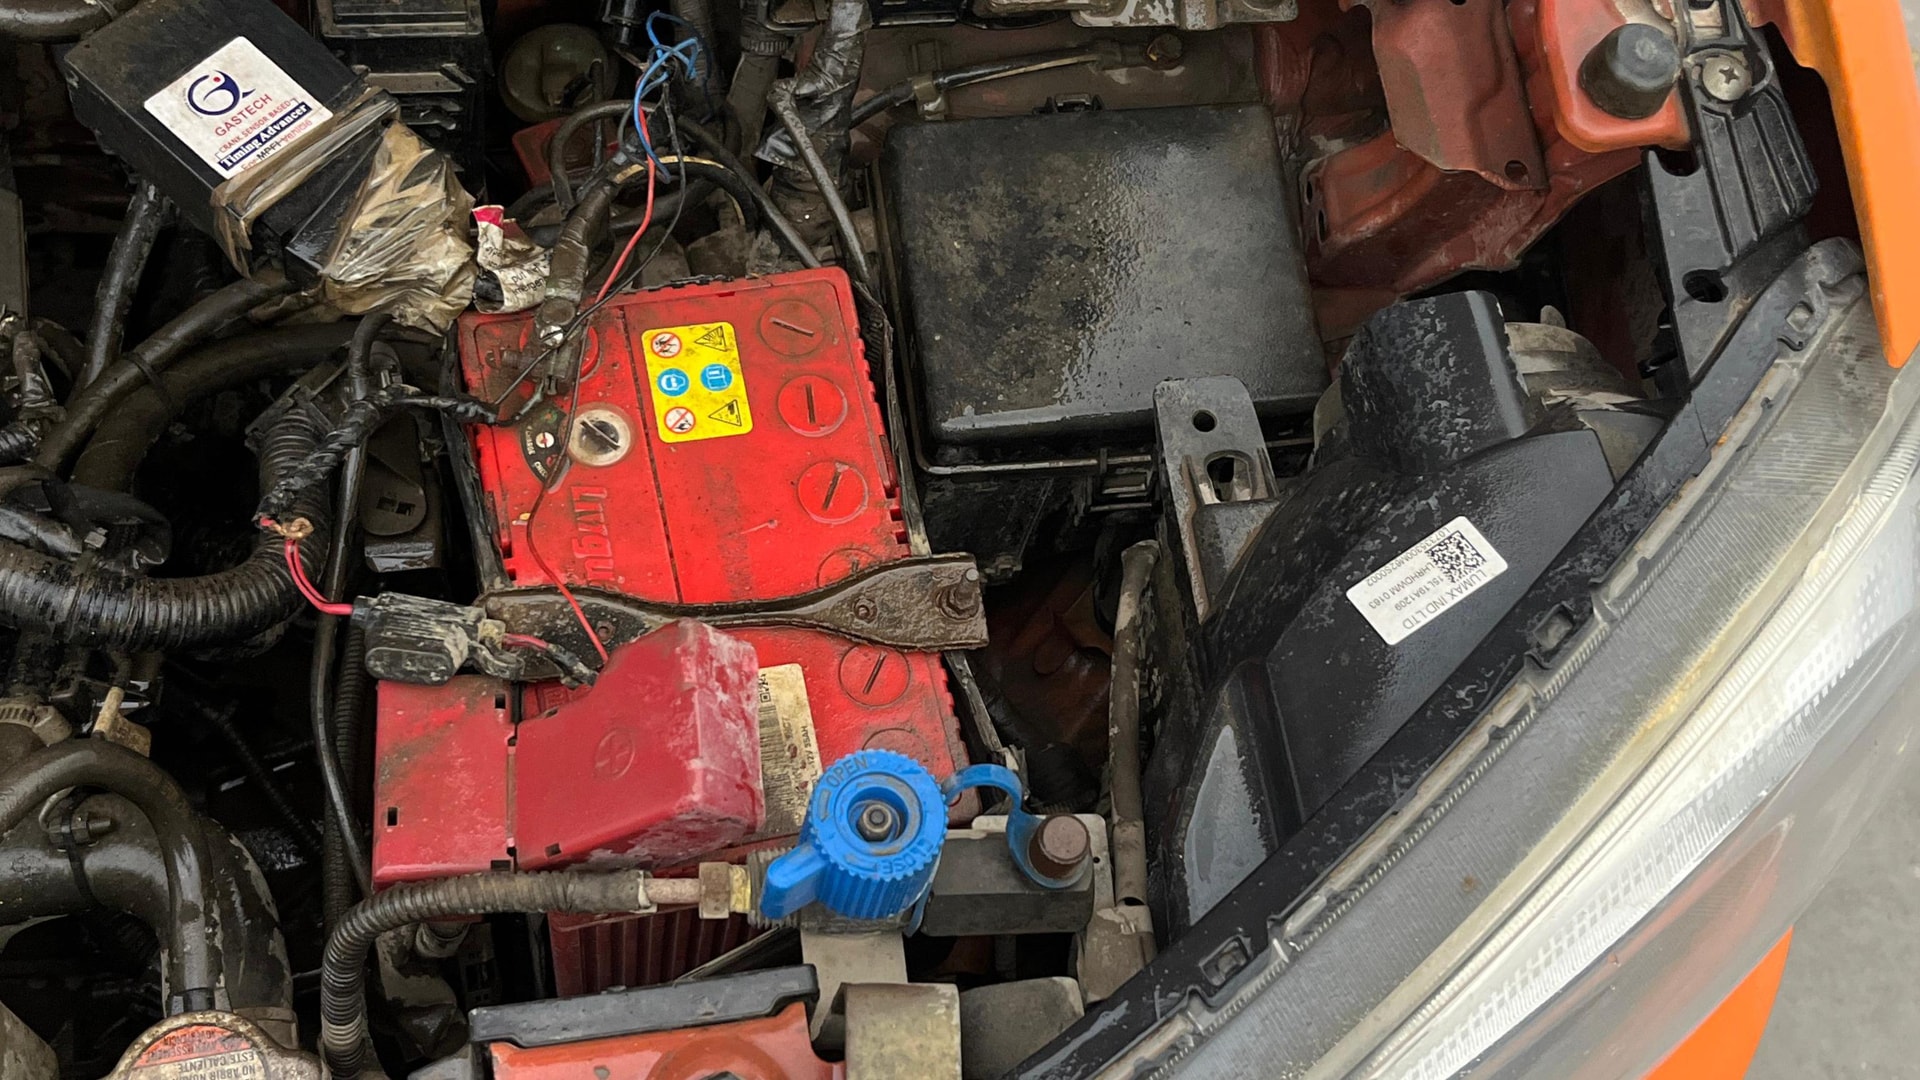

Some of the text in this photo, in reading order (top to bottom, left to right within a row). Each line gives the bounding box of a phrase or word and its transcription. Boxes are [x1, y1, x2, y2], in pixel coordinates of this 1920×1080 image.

[215, 94, 273, 137] GASTECH
[220, 100, 291, 153] CRANK SENSOR BASED
[221, 104, 307, 167] Timing Advancer
[1402, 569, 1487, 630] LUMAX IND LTD
[826, 754, 869, 788] OPEN
